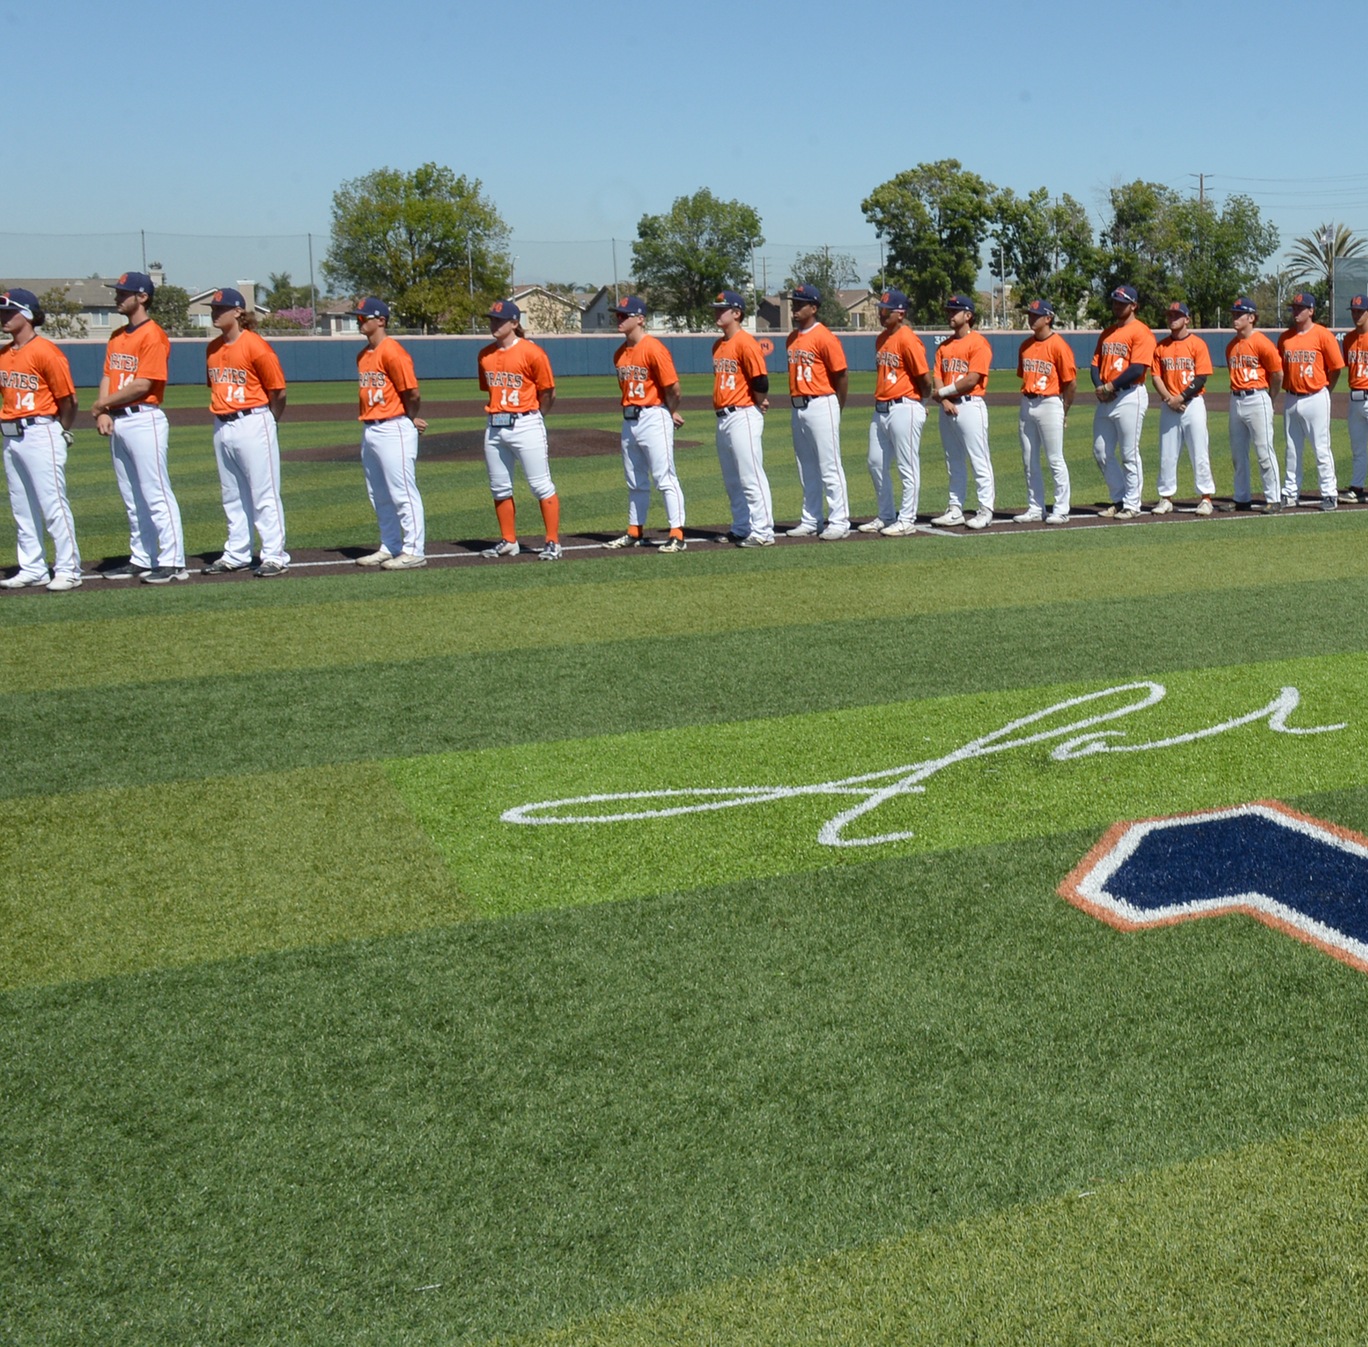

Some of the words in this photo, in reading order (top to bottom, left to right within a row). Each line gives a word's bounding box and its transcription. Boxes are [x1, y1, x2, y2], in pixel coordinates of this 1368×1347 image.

[1110, 357, 1123, 372] 4
[1299, 363, 1313, 379] 14
[796, 365, 812, 382] 14
[885, 369, 897, 384] 4
[1242, 368, 1258, 383] 14
[627, 381, 645, 398] 14
[720, 374, 736, 391] 14
[15, 391, 35, 411] 14
[226, 385, 246, 403] 14
[368, 389, 385, 407] 14
[500, 388, 519, 406] 14
